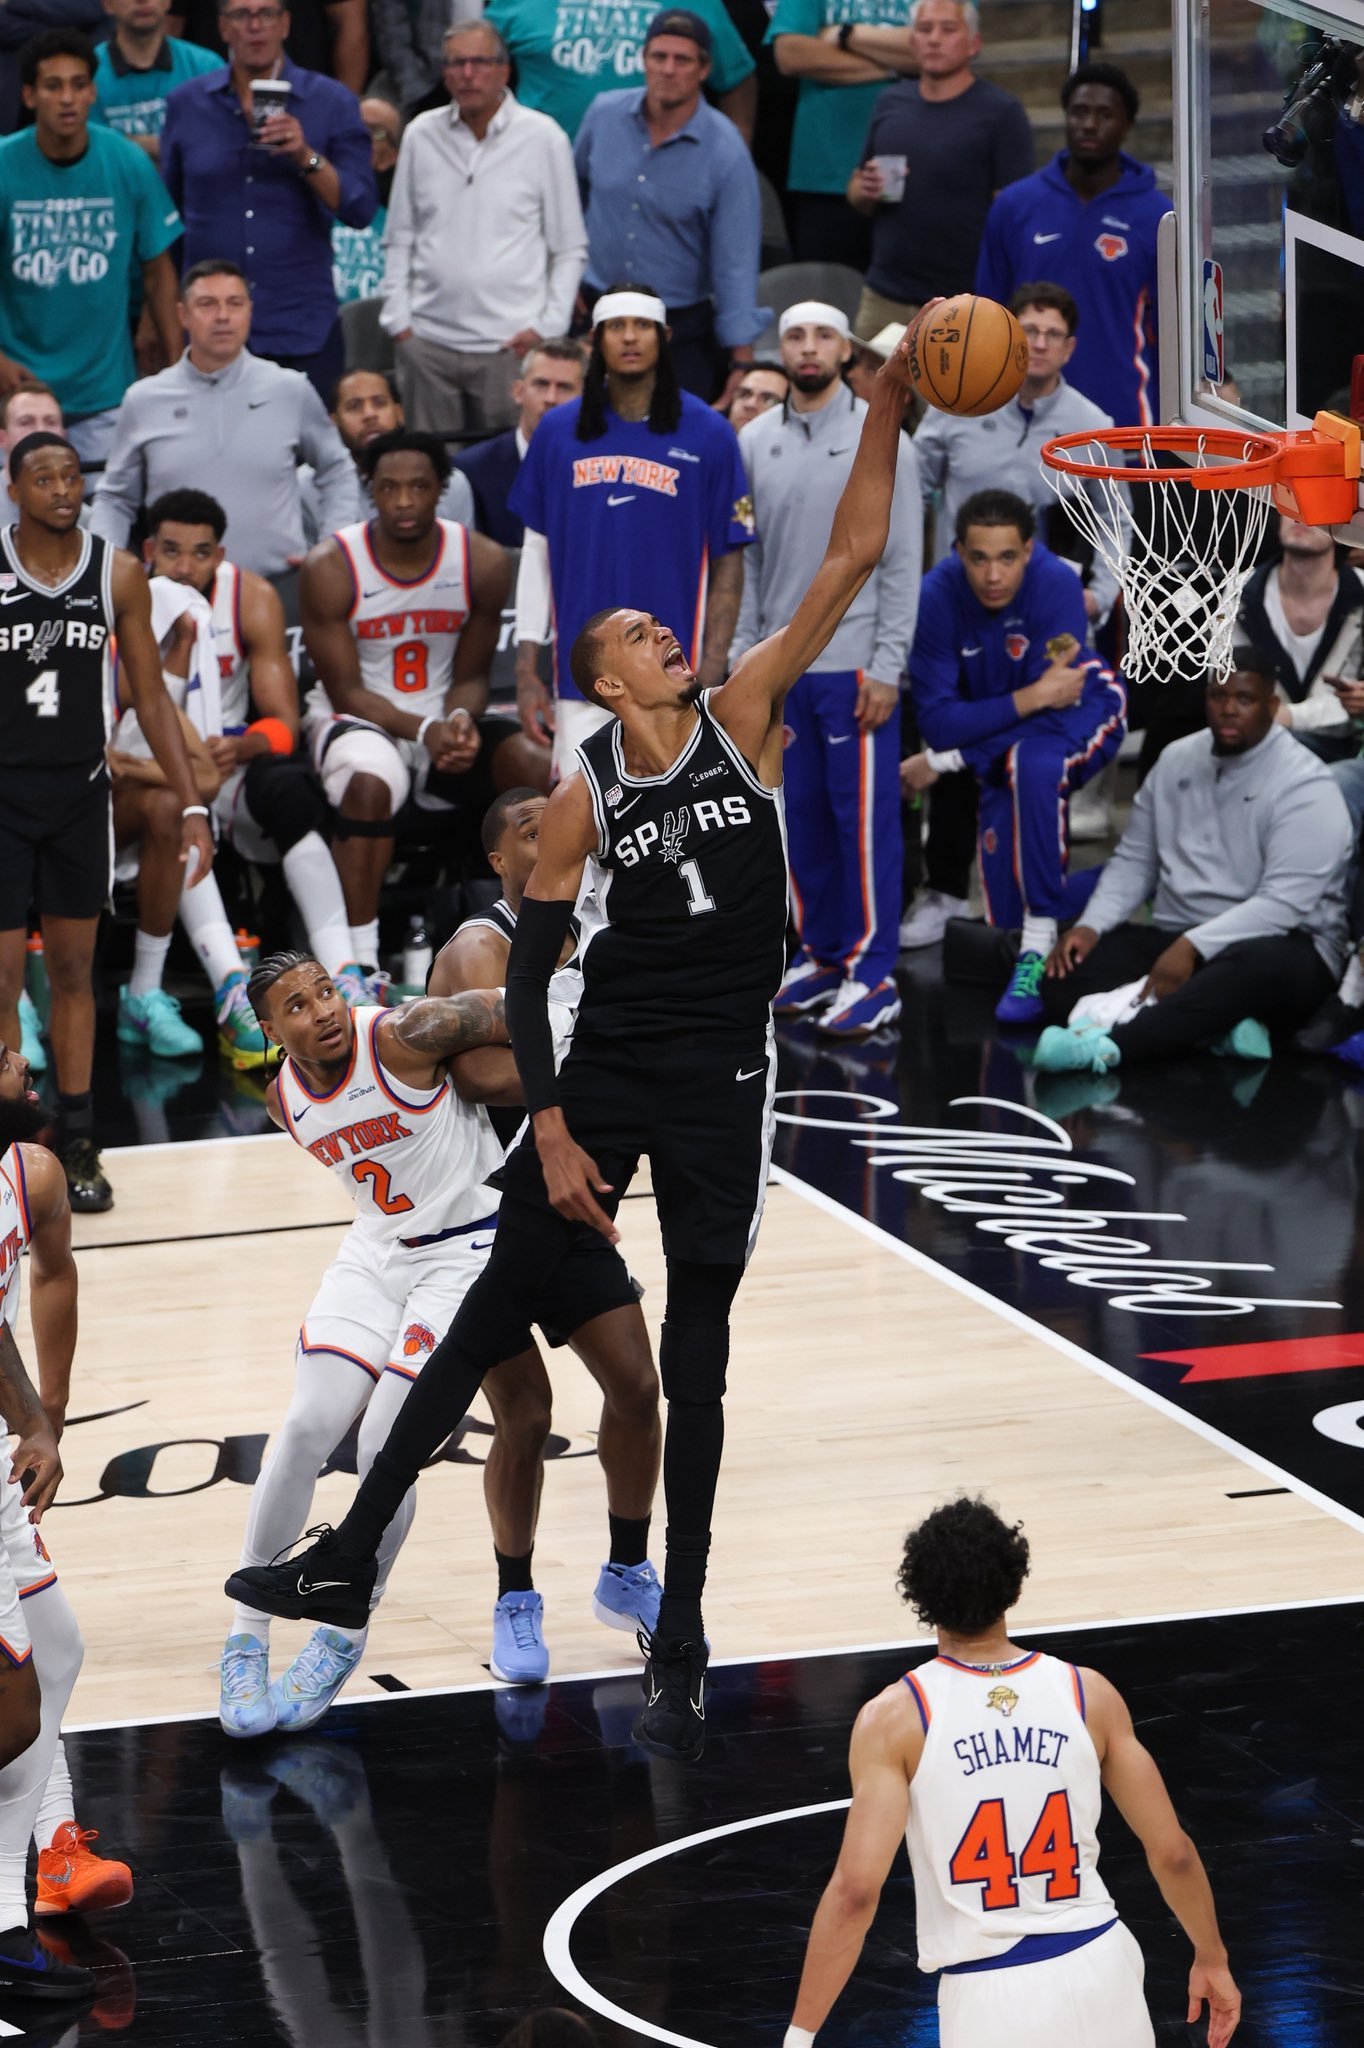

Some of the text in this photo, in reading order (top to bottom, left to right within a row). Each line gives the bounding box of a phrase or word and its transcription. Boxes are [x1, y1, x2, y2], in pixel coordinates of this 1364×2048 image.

[12, 210, 117, 253] FINALS
[12, 247, 109, 286] GO GO
[573, 456, 680, 497] NEW YORK
[357, 609, 465, 640] NEW YORK
[393, 640, 429, 693] 8
[26, 669, 60, 717] 4
[694, 765, 724, 783] LEDGER
[677, 858, 717, 916] 1
[338, 1112, 414, 1155] YORK
[352, 1158, 415, 1215] 2
[953, 1726, 1069, 1776] SHAMET
[949, 1788, 1081, 1912] 44
